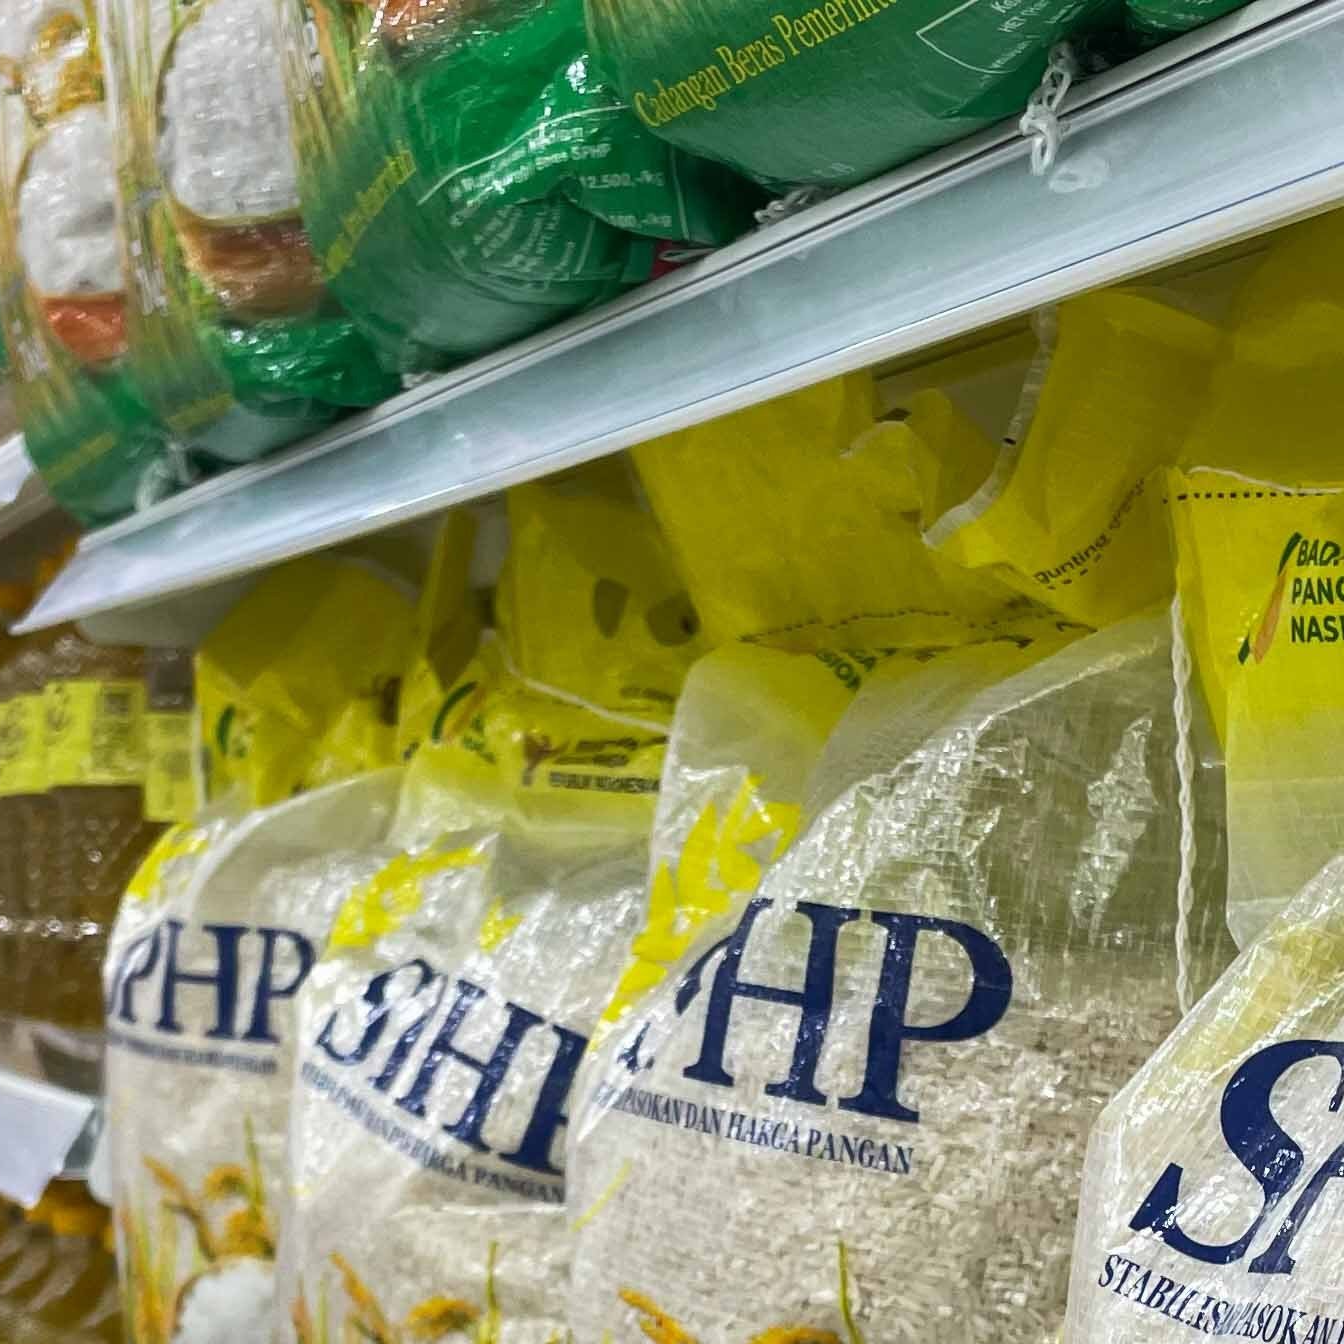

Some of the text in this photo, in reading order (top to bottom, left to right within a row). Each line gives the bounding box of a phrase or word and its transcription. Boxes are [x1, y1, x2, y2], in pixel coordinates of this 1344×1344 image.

[633, 79, 732, 127] Cadangan
[713, 45, 785, 85] Beras
[110, 914, 317, 1044] PHP
[684, 1101, 727, 1137] DAN
[804, 1128, 916, 1176] PANGAN
